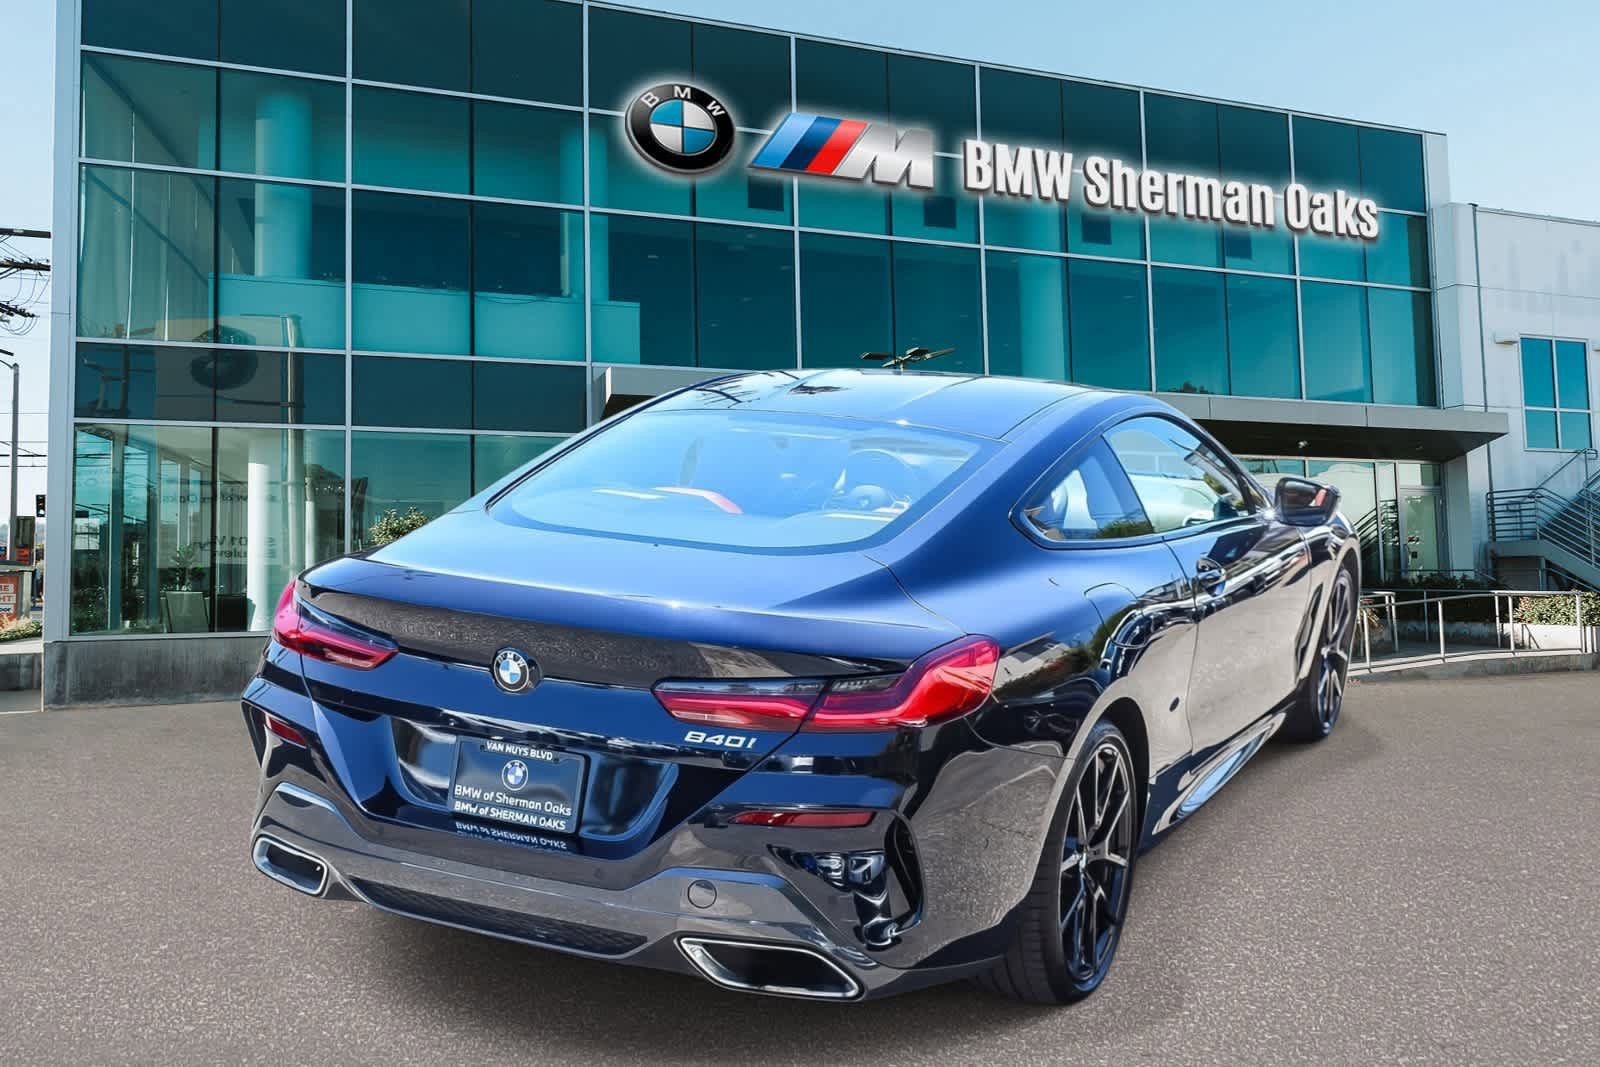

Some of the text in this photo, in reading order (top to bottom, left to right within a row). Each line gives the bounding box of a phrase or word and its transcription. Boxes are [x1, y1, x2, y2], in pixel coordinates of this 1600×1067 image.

[641, 85, 726, 118] BMW
[963, 139, 1379, 240] BMW Sherman Oaks
[486, 741, 553, 760] VAN NUYS BLVD
[454, 784, 572, 816] BMW of Sherman Oaks
[454, 801, 566, 830] BMW of SHERMAN OAKS
